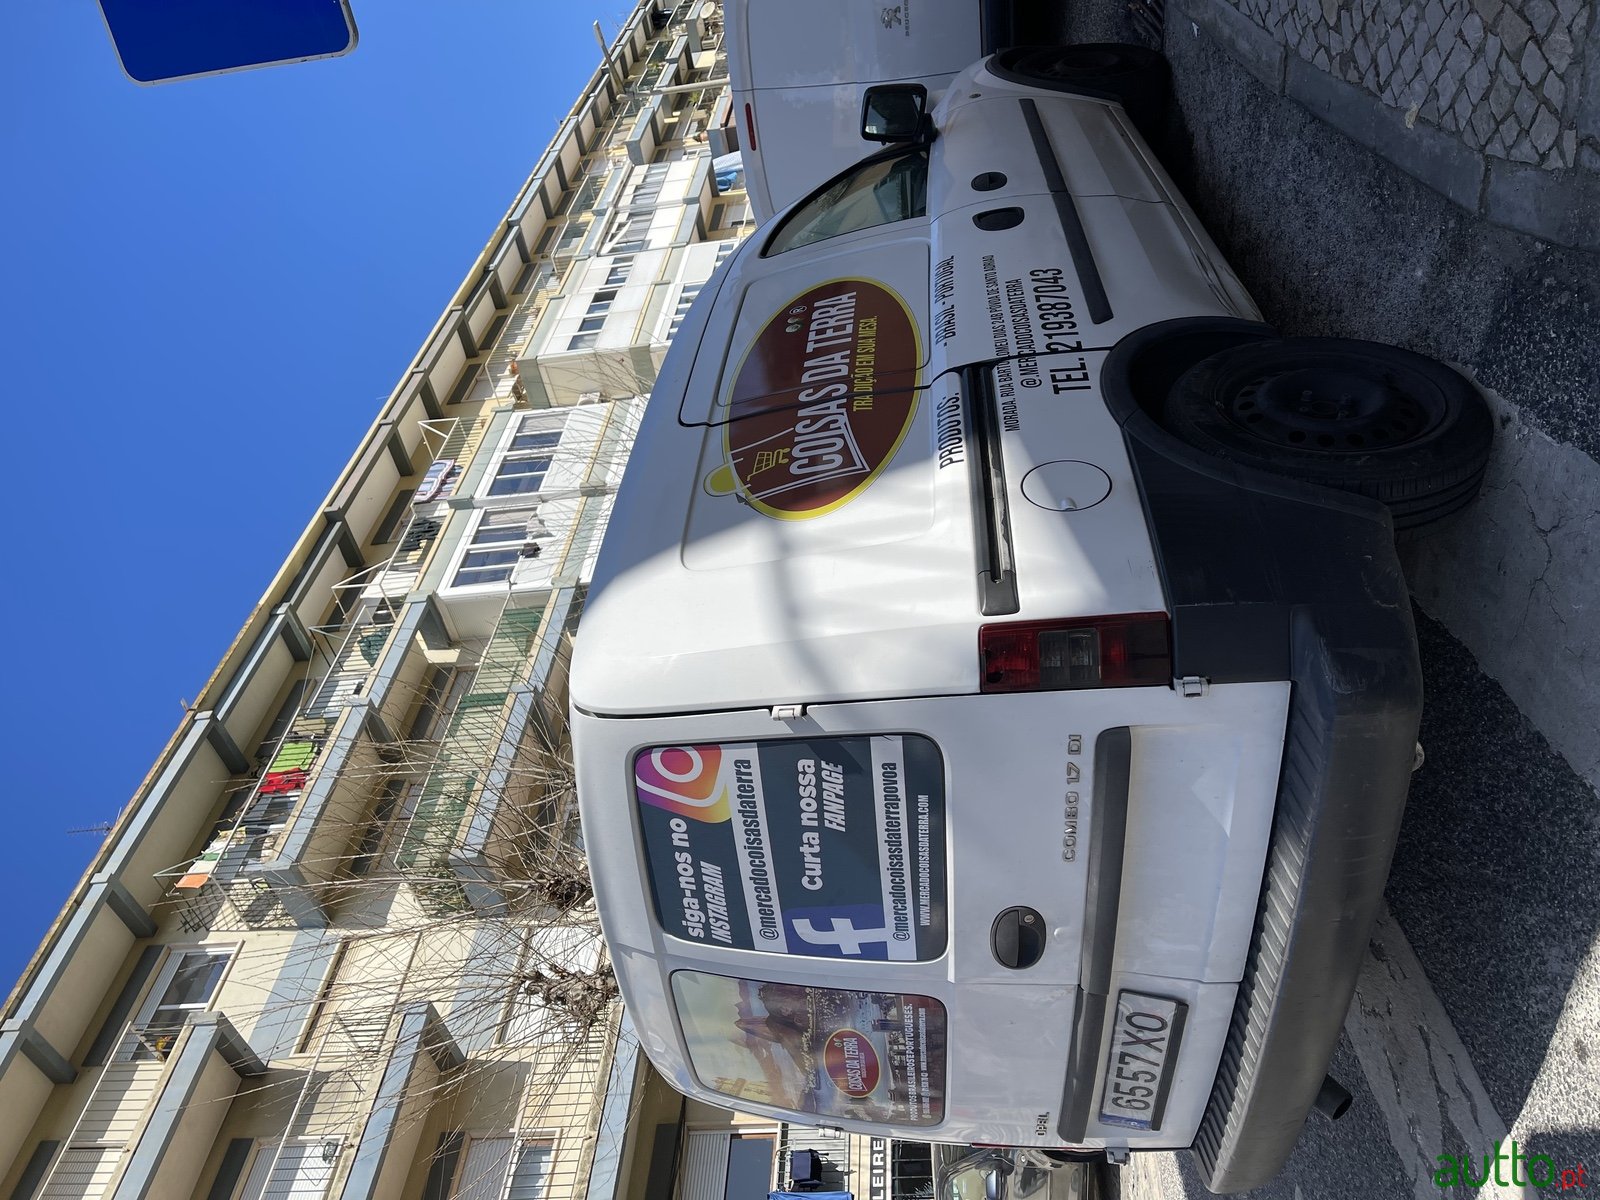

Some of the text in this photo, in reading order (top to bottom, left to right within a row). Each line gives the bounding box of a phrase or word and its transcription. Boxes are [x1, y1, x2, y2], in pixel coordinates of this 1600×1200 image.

[935, 255, 954, 304] PORTUGAL
[935, 304, 956, 344] BRASIL
[991, 324, 1007, 338] DIAS
[1030, 268, 1091, 394] TEL. 219387043
[789, 292, 856, 474] COISAS DA TERRA
[850, 316, 877, 411] TRADIÇÃO EM SUA MESA.
[999, 382, 1015, 397] RUA
[937, 392, 964, 469] PRODUTOS:
[1002, 398, 1020, 432] MORADA.
[1068, 734, 1081, 755] DI
[797, 759, 823, 891] Curta nossa
[821, 760, 846, 832] FANPAGE
[1062, 791, 1079, 862] COMBO
[669, 818, 706, 938] siga-nos no
[734, 759, 780, 940] @mercadocoisasdaterra
[881, 762, 910, 941] @mercadocoisasdaterrapovoa
[917, 794, 931, 926] WWW.MERCADOCOISASDATERRA.COM
[700, 861, 732, 944] INSTAGRAM
[843, 1038, 858, 1058] TERRA
[846, 1060, 860, 1068] DA
[906, 1059, 917, 1095] BRASILEIROS
[1112, 1012, 1168, 1110] 6557XO
[909, 1095, 918, 1121] PRODUTOS
